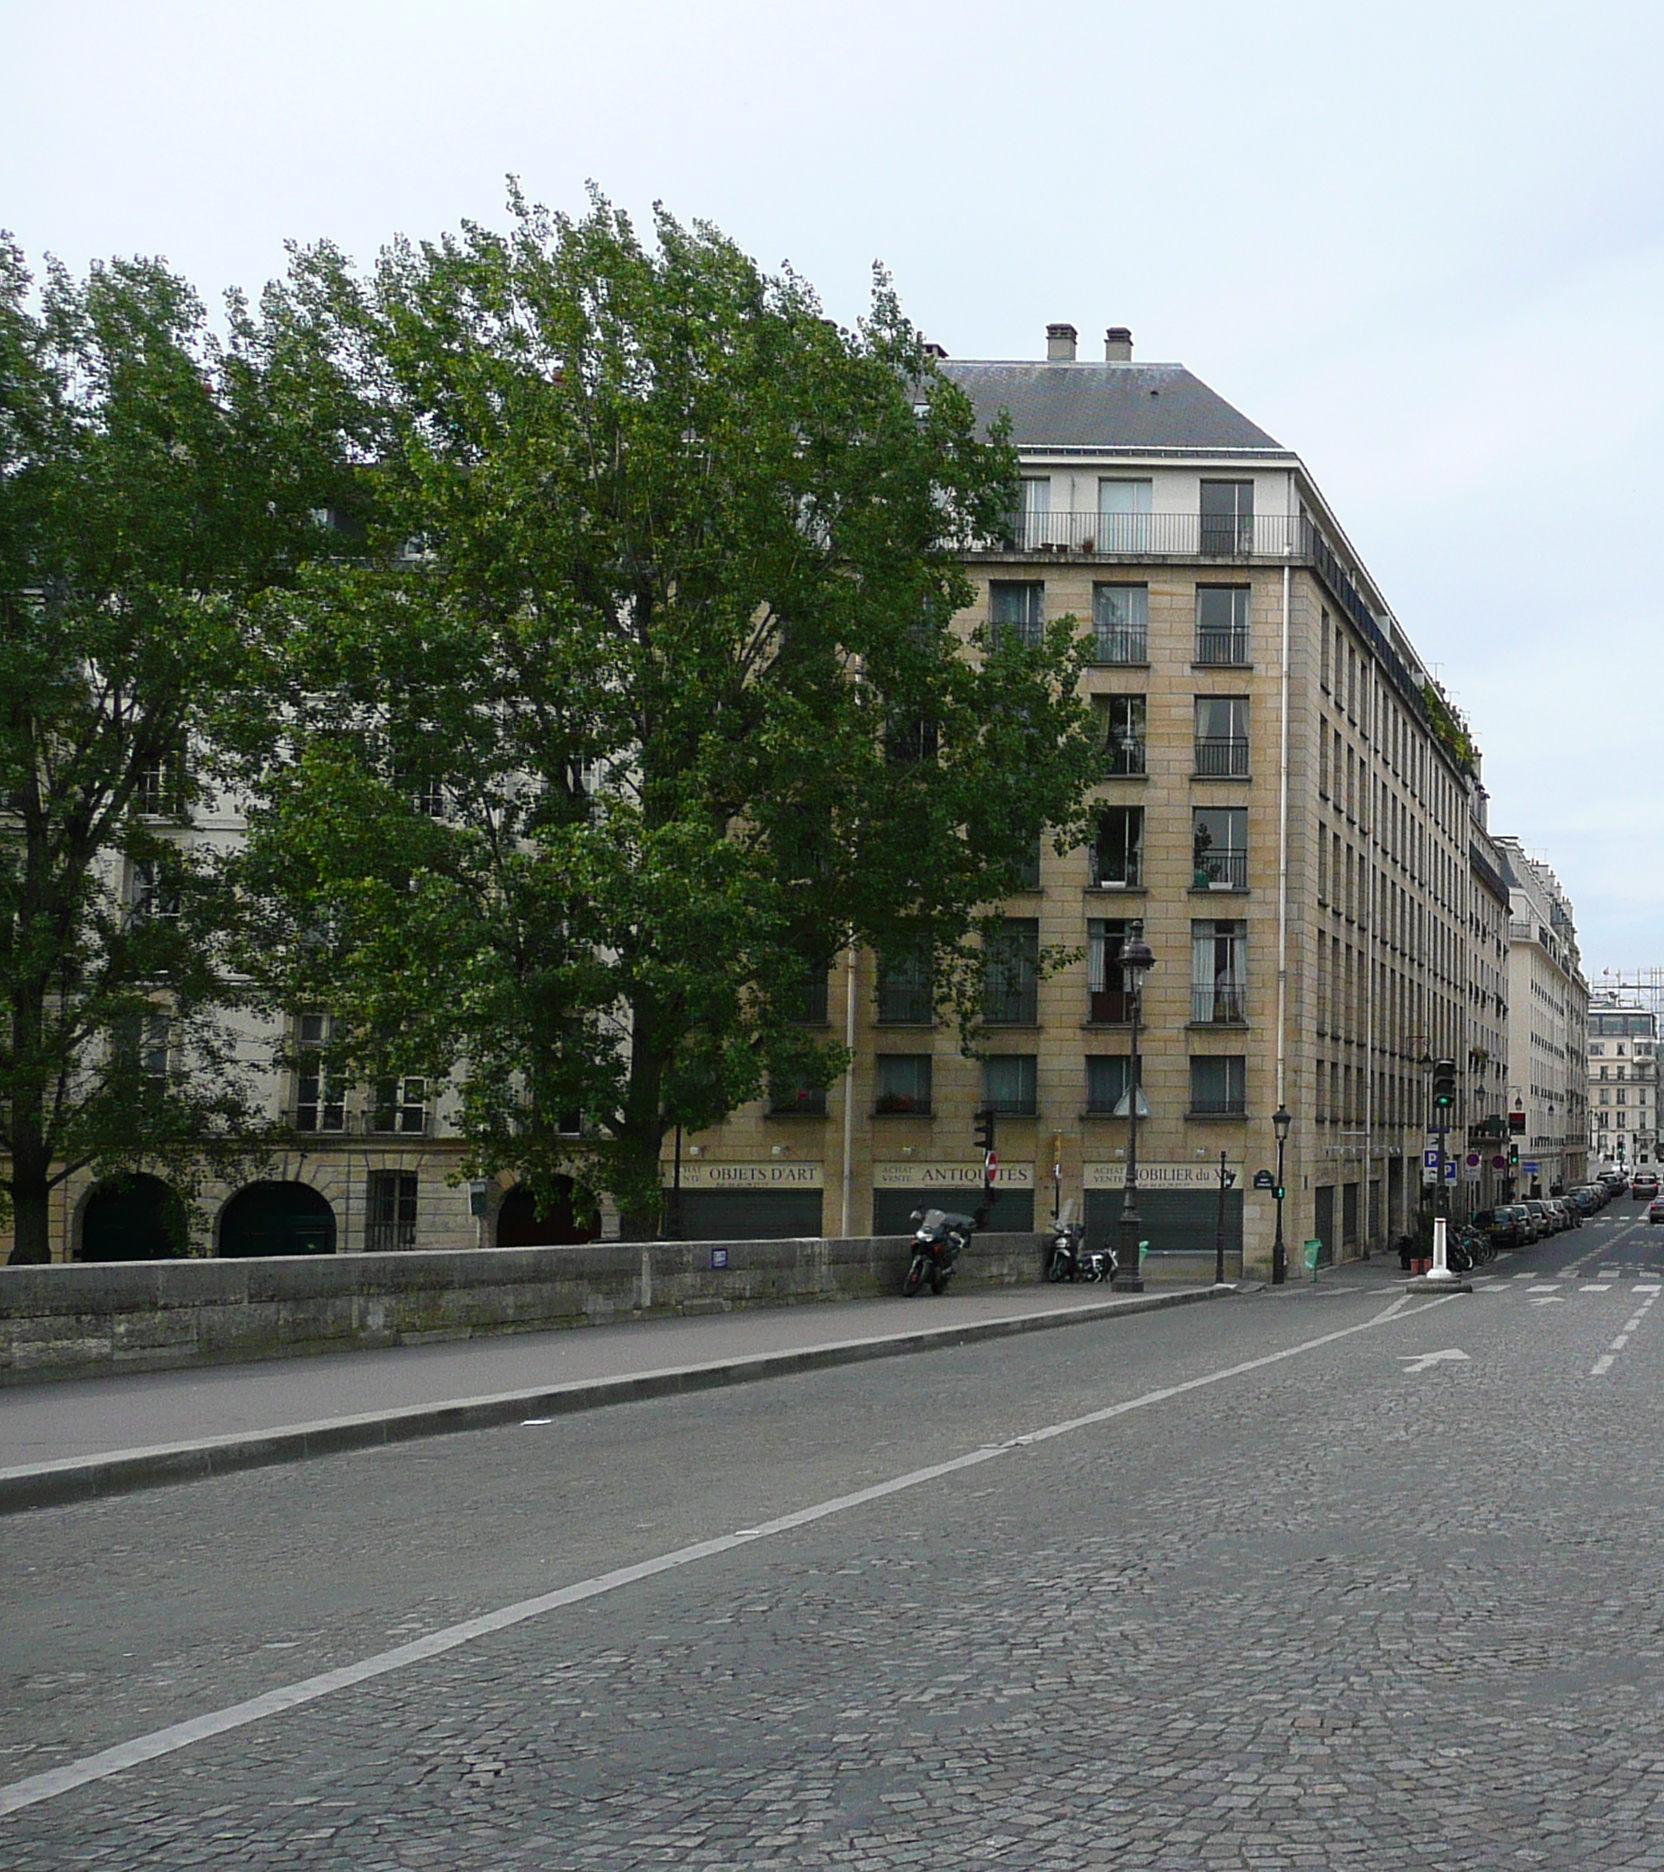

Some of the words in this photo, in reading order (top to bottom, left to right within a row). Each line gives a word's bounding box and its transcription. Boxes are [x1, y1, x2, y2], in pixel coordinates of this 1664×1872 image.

[1428, 1153, 1437, 1165] P
[709, 1167, 767, 1181] OBJETS
[771, 1167, 817, 1181] D'ART
[922, 1164, 1028, 1182] ANTIQUTÉS
[1134, 1167, 1194, 1182] OBILIER
[1196, 1167, 1210, 1181] du
